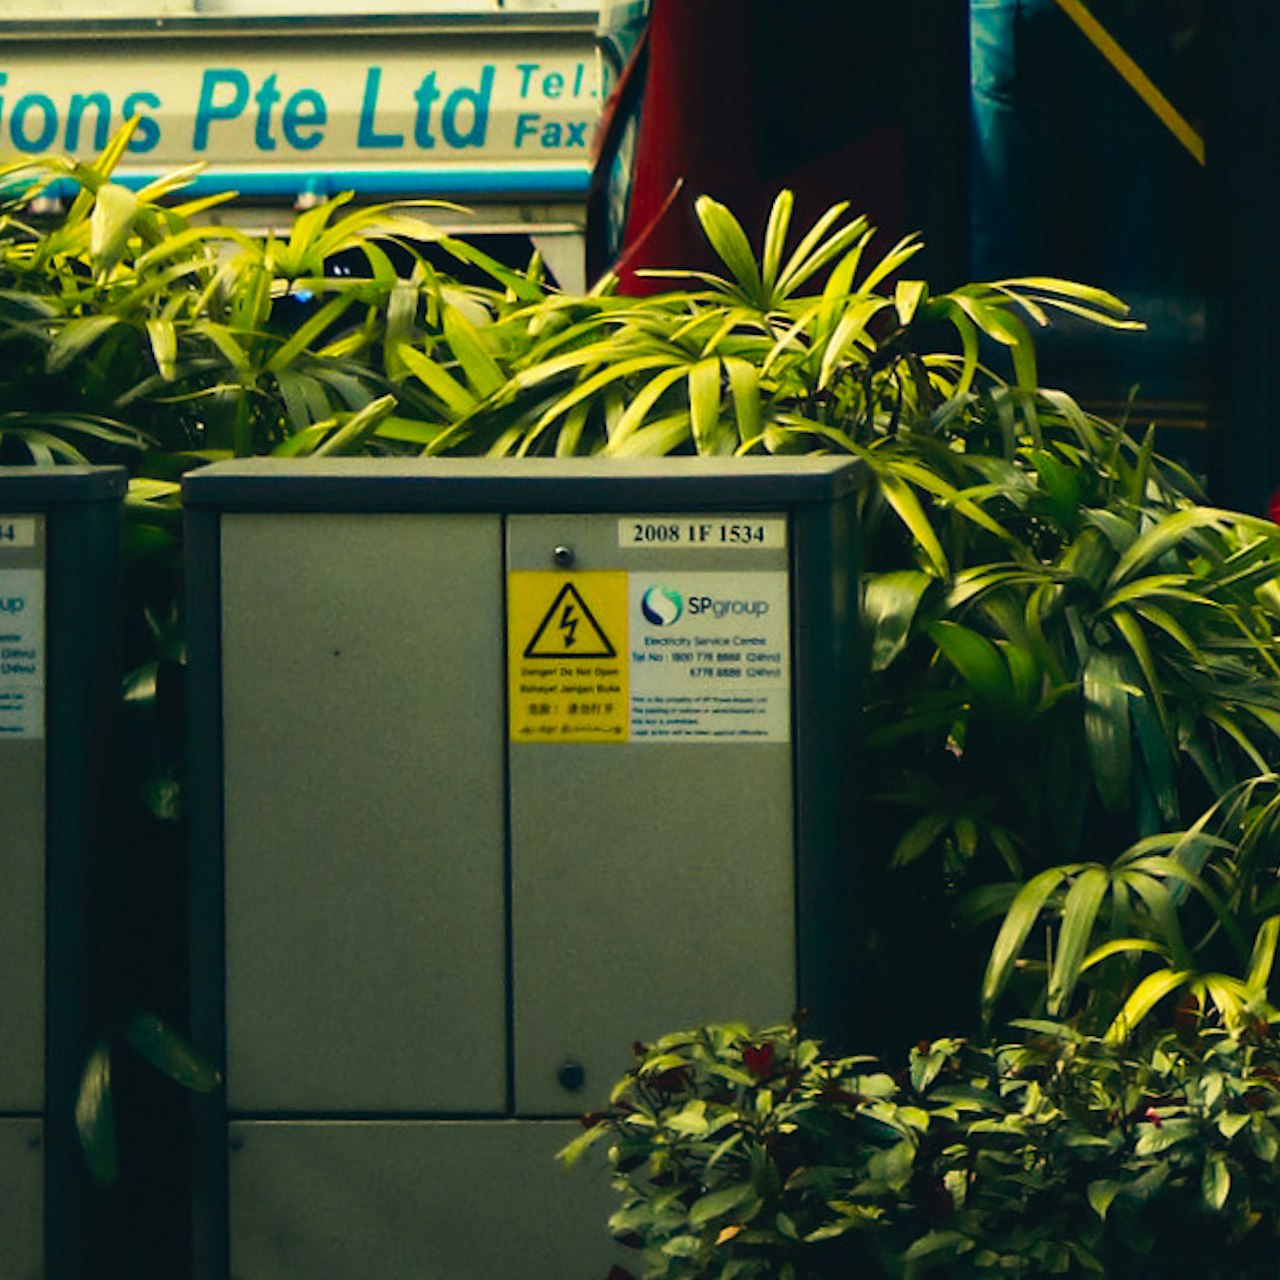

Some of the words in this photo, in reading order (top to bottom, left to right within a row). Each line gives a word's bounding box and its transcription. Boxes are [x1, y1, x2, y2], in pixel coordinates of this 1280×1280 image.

[193, 68, 327, 151] Pte
[357, 65, 496, 149] Ltd
[513, 112, 587, 148] Fax
[634, 524, 680, 542] 2008
[719, 525, 765, 543] 1534
[688, 597, 769, 618] SPgroup
